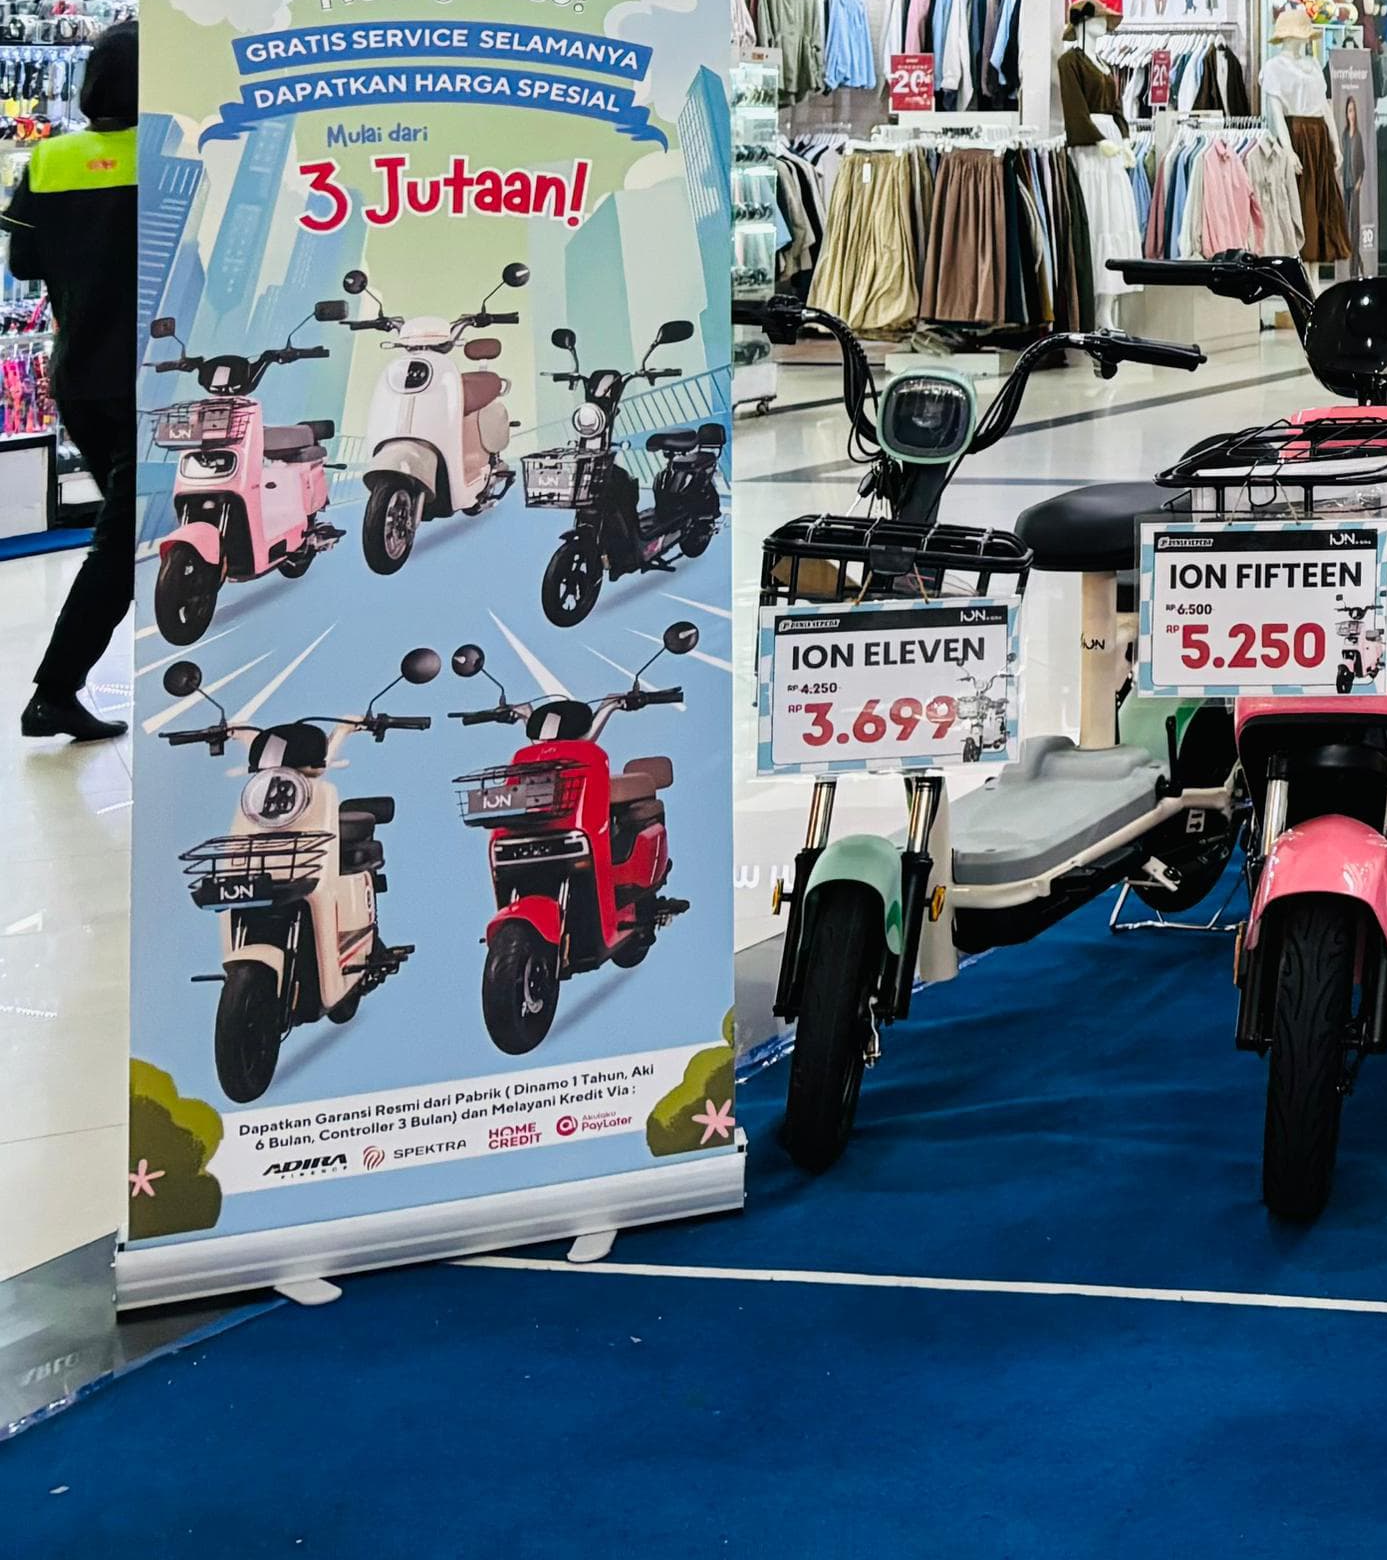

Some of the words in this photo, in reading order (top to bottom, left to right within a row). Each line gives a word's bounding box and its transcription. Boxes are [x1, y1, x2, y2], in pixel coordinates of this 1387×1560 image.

[245, 31, 347, 63] GRATIS
[351, 28, 468, 51] SERVICE
[478, 29, 640, 70] SELAMANYA
[253, 75, 404, 110] DAPATKAN
[414, 73, 512, 95] HARGA
[516, 79, 621, 113] SPESIAL
[326, 122, 385, 148] Mulai
[388, 124, 429, 144] dari
[298, 160, 351, 232] 3
[364, 155, 591, 229] Jutaan!
[1329, 533, 1355, 546] ION
[1170, 564, 1227, 590] ION
[1236, 562, 1363, 589] FIFTEEN
[960, 610, 986, 624] ION
[1177, 603, 1213, 616] 6.500
[792, 642, 854, 671] ION
[863, 636, 986, 667] ELEVEN
[1166, 624, 1180, 635] RP
[1181, 622, 1327, 670] 5.250
[787, 684, 799, 693] RP
[800, 681, 838, 695] 4.250
[788, 704, 802, 714] RP
[802, 696, 959, 747] 3.699
[483, 791, 513, 810] ION
[219, 882, 254, 901] ION
[238, 1115, 312, 1138] Dapatkan
[315, 1101, 373, 1125] Garansi
[375, 1098, 420, 1118] Resmi
[423, 1095, 453, 1111] dari
[455, 1084, 502, 1106] Pabrik
[514, 1077, 569, 1097] Dinamo
[571, 1075, 578, 1089] 1
[580, 1067, 628, 1089] Tahun,
[631, 1063, 655, 1080] Aki
[255, 1138, 265, 1152] 6
[268, 1131, 316, 1151] Bulan,
[318, 1118, 395, 1144] Controller
[398, 1117, 408, 1132] 3
[410, 1110, 458, 1130] Bulan)
[460, 1106, 489, 1123] dan
[492, 1096, 557, 1120] Melayani
[559, 1087, 605, 1108] Kredit
[607, 1084, 630, 1098] Via
[488, 1122, 537, 1138] HOME
[488, 1132, 543, 1150] CREDIT
[580, 1114, 633, 1133] PayLater
[261, 1152, 348, 1177] ADIRA
[393, 1139, 467, 1160] SPEKTRA
